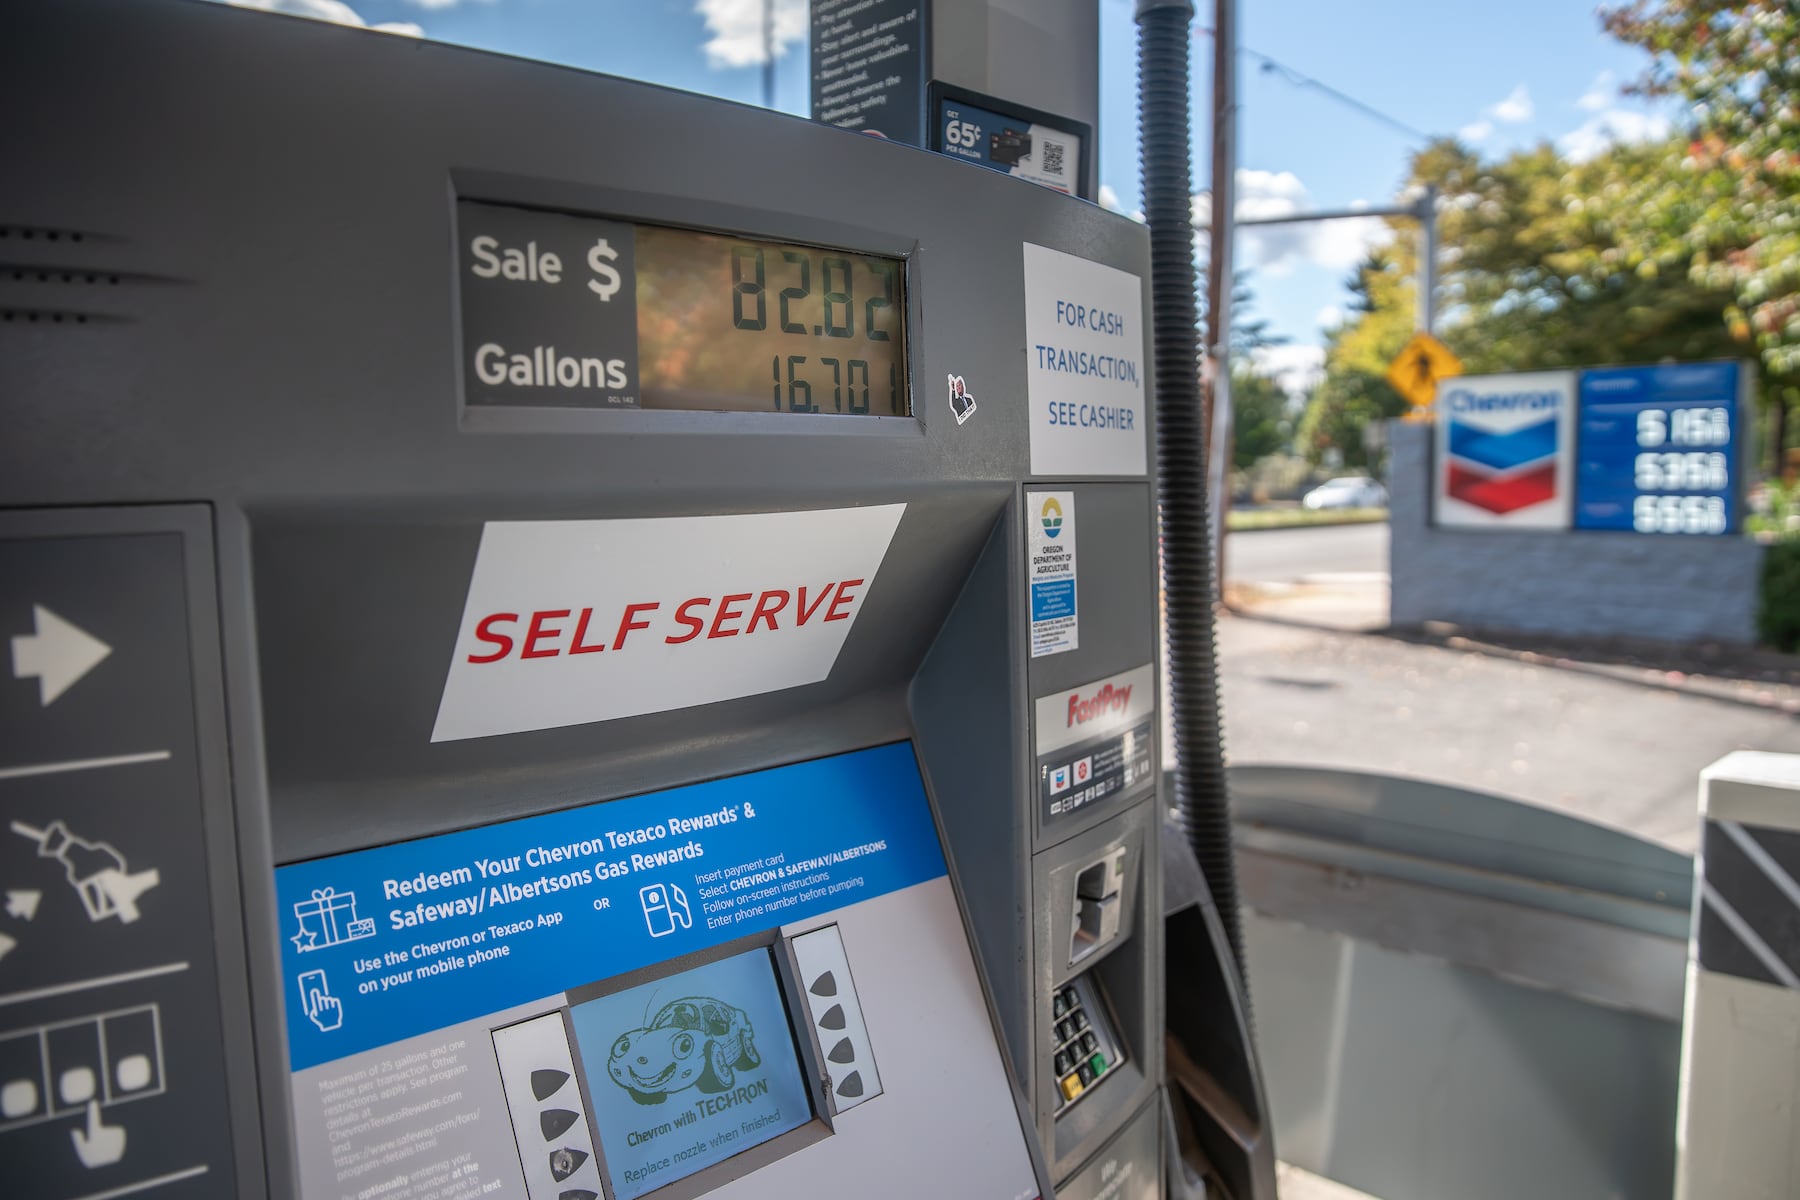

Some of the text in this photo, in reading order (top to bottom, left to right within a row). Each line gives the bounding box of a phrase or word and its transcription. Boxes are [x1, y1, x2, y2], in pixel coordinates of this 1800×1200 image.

[471, 235, 622, 303] Sale $
[1057, 300, 1124, 337] FOR CASH
[474, 343, 628, 390] Gallons
[1036, 345, 1139, 388] TRANSACTION,
[1049, 401, 1135, 431] SEE CASHIER
[1449, 388, 1562, 413] Chevron
[1033, 554, 1065, 565] DEPARTMENT
[1036, 563, 1069, 574] AGRICULTURE
[1043, 545, 1063, 554] OREGON
[467, 578, 865, 664] SELF SERVE
[1067, 683, 1133, 728] FastPay
[383, 866, 473, 901] Redeem
[474, 855, 521, 880] Your
[526, 836, 605, 868] Chevron
[605, 823, 666, 849] Texaco
[743, 802, 756, 819] &
[695, 852, 785, 886] Insert payment card
[699, 839, 888, 900] Select CHEVRON & SAFEWAY/ALBERTSONS
[389, 840, 704, 931] Safeway/Albertsons Gas Rewards
[593, 897, 611, 911] OR
[703, 871, 830, 914] Follow on-screen instructions
[707, 875, 865, 930] Enter phone number before pumping
[353, 911, 564, 975] Use the Chevron or Texaco App
[358, 944, 511, 995] on your mobile phone
[395, 1051, 428, 1071] gallons
[430, 1045, 447, 1058] and
[449, 1040, 466, 1051] one
[430, 1064, 468, 1084] program
[432, 1055, 458, 1069] Other
[627, 1078, 769, 1147] Chevron with TECHRON
[623, 1108, 782, 1184] Replace nozzle when finished
[463, 1162, 479, 1175] the
[482, 1177, 502, 1194] text
